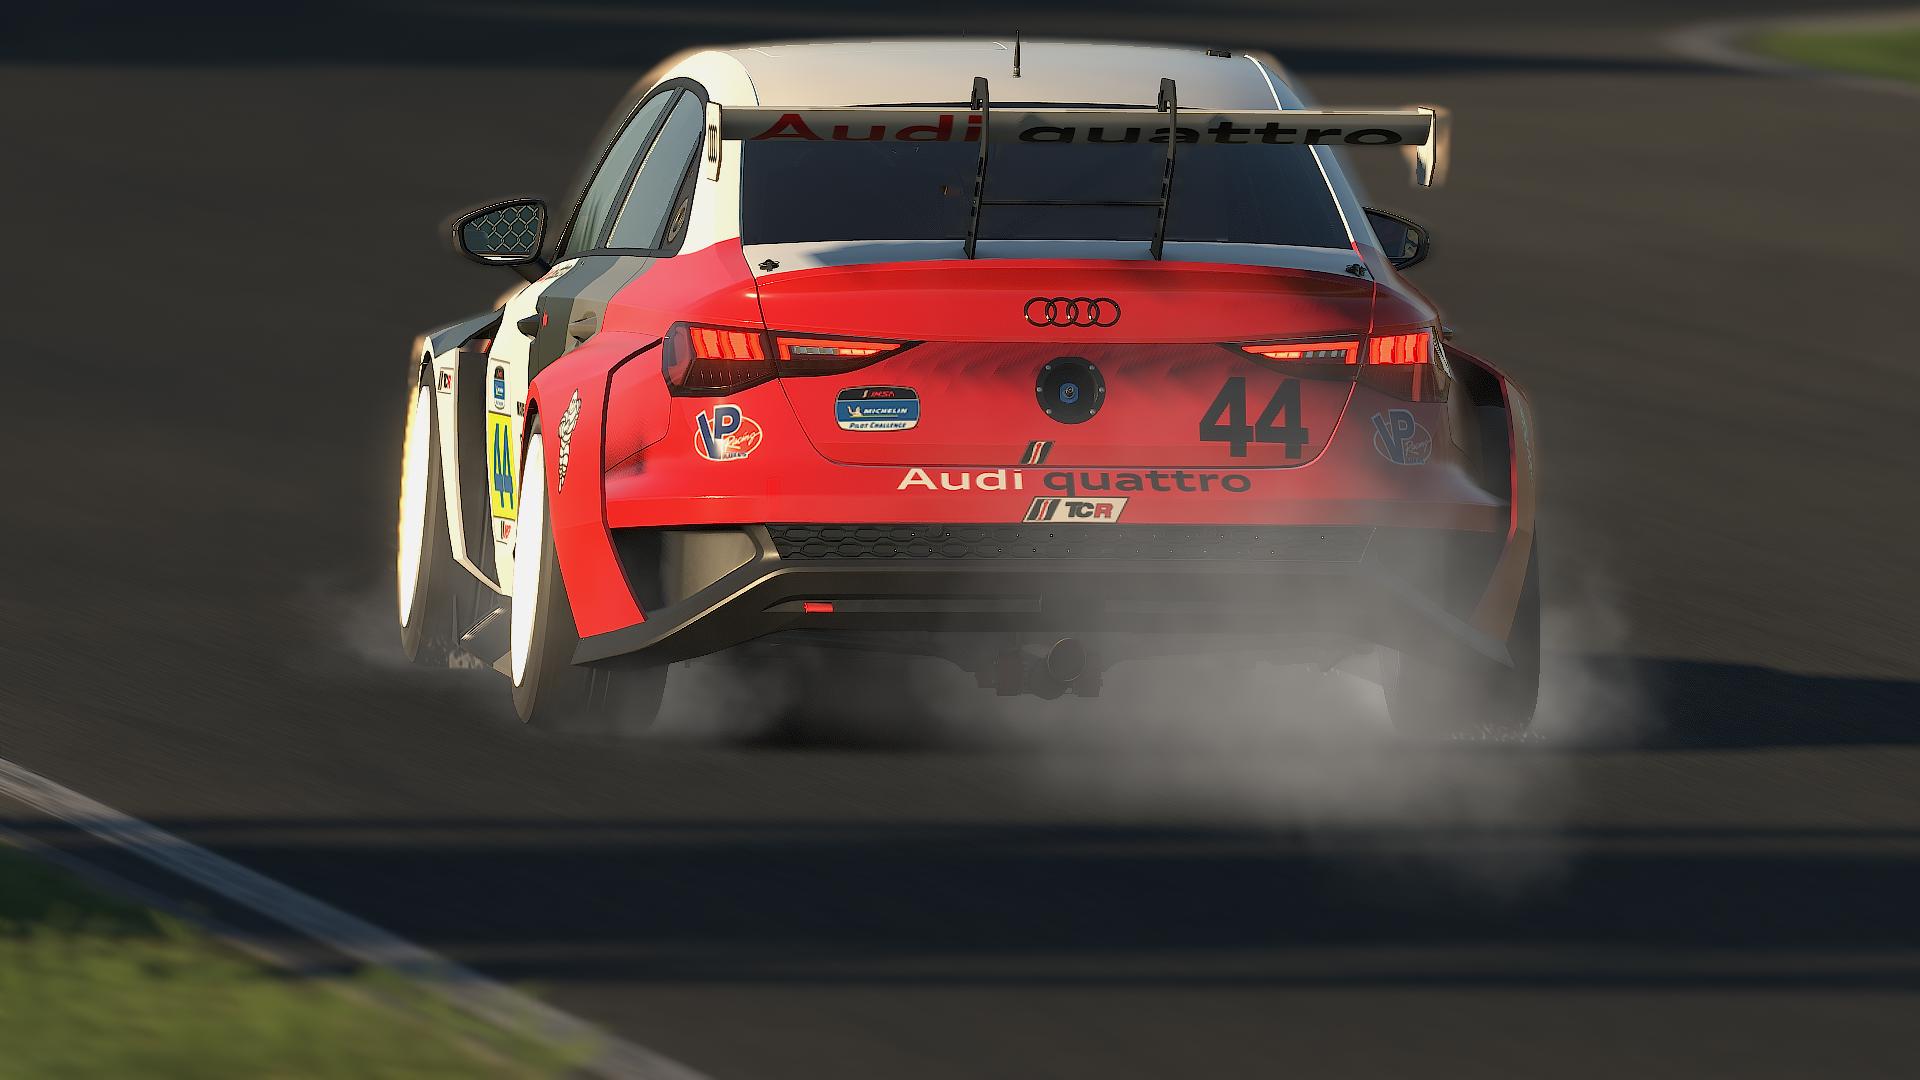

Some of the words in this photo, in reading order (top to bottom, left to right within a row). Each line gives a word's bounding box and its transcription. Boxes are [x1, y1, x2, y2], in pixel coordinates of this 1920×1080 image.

[751, 113, 982, 141] Audi
[696, 404, 742, 461] VP
[1199, 376, 1309, 459] 44
[494, 423, 513, 509] 44
[897, 468, 1024, 490] Audi
[1043, 470, 1251, 498] quattro
[1065, 501, 1113, 519] TCR
